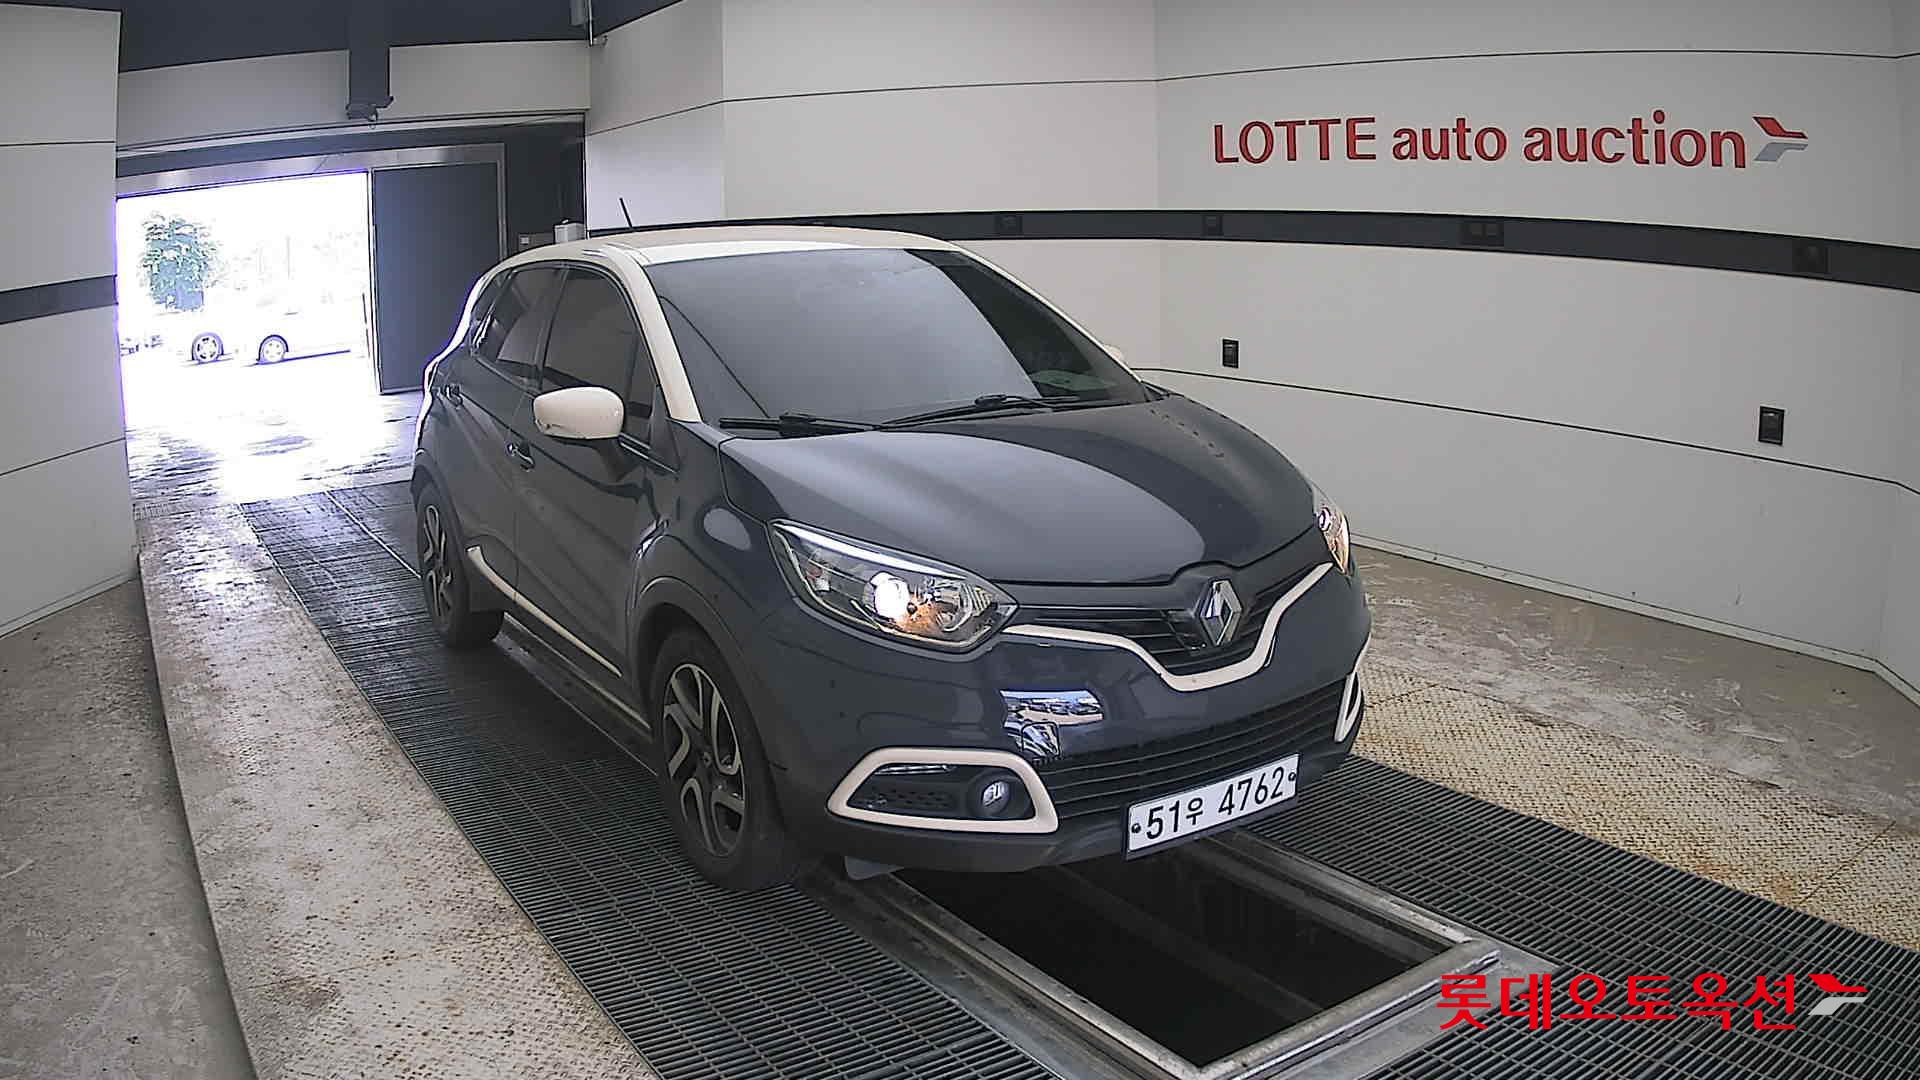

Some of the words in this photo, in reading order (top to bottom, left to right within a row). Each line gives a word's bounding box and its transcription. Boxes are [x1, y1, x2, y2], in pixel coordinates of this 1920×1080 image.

[1214, 117, 1377, 164] LOTTE
[1392, 117, 1509, 162] auto
[1523, 109, 1747, 169] auction
[1146, 797, 1204, 840] 51우
[1218, 766, 1285, 815] 4762
